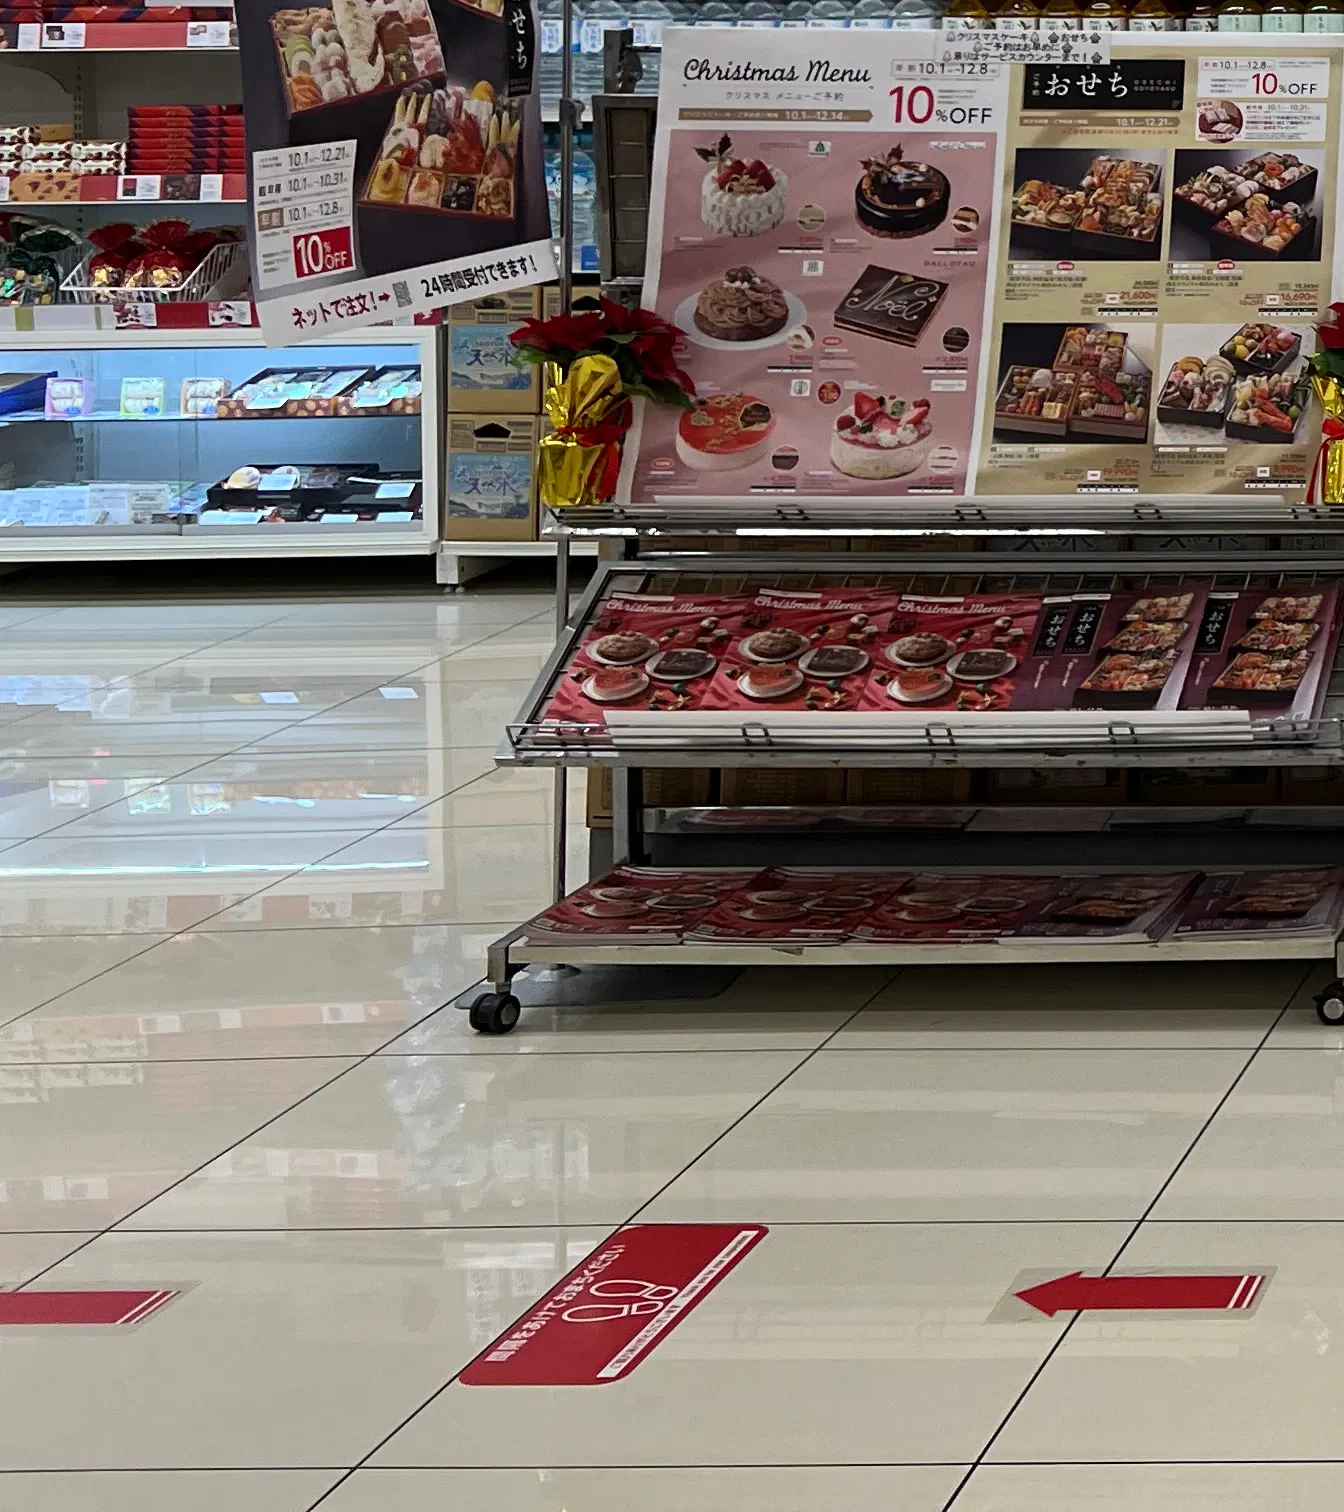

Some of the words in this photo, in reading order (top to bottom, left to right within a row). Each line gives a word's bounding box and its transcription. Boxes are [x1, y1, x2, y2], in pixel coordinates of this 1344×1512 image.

[683, 58, 800, 82] Christmas
[804, 59, 872, 82] Menu
[726, 91, 771, 101] クリスマス
[1045, 72, 1129, 97] おせち
[606, 599, 674, 614] Christmas
[676, 602, 716, 614] Menu
[754, 595, 823, 610] Christmas
[824, 598, 865, 611] Menu
[897, 600, 965, 615] Christmas
[967, 602, 1007, 615] Menu
[1047, 613, 1065, 648] おせち
[1075, 612, 1094, 647] おせち
[1206, 611, 1225, 645] おせち
